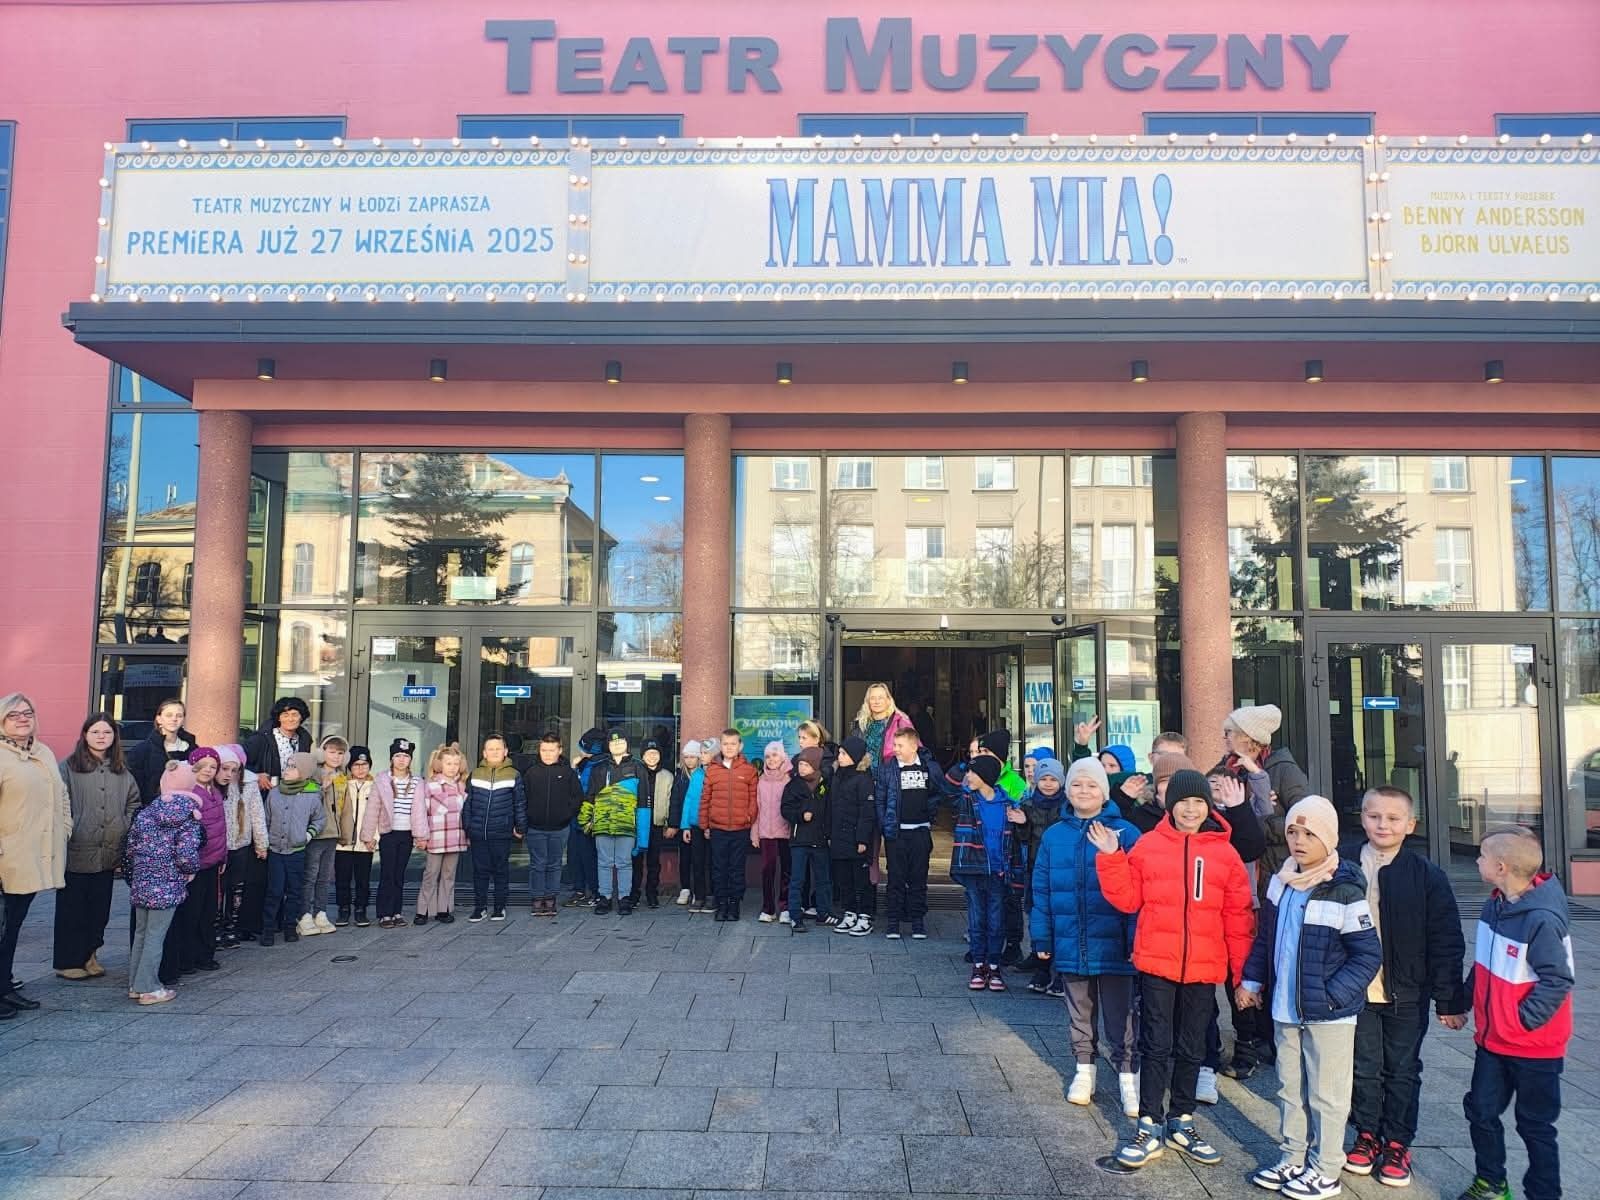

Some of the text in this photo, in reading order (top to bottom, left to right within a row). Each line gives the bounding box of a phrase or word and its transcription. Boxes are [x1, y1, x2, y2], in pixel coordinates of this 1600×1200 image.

[484, 18, 1348, 95] TEATR MUZYCZNY
[192, 197, 242, 214] TEATR
[250, 197, 333, 214] MUZYCZNY
[340, 197, 352, 213] W
[408, 195, 491, 213] ZAPRASZA
[1402, 206, 1586, 227] BENNY ANDERSSON
[766, 174, 1173, 268] MAMMA MIA!
[256, 225, 298, 255] JUŻ
[311, 228, 343, 255] 27
[487, 228, 554, 255] 2025
[1420, 233, 1571, 257] BJÖRN ULVAEUS
